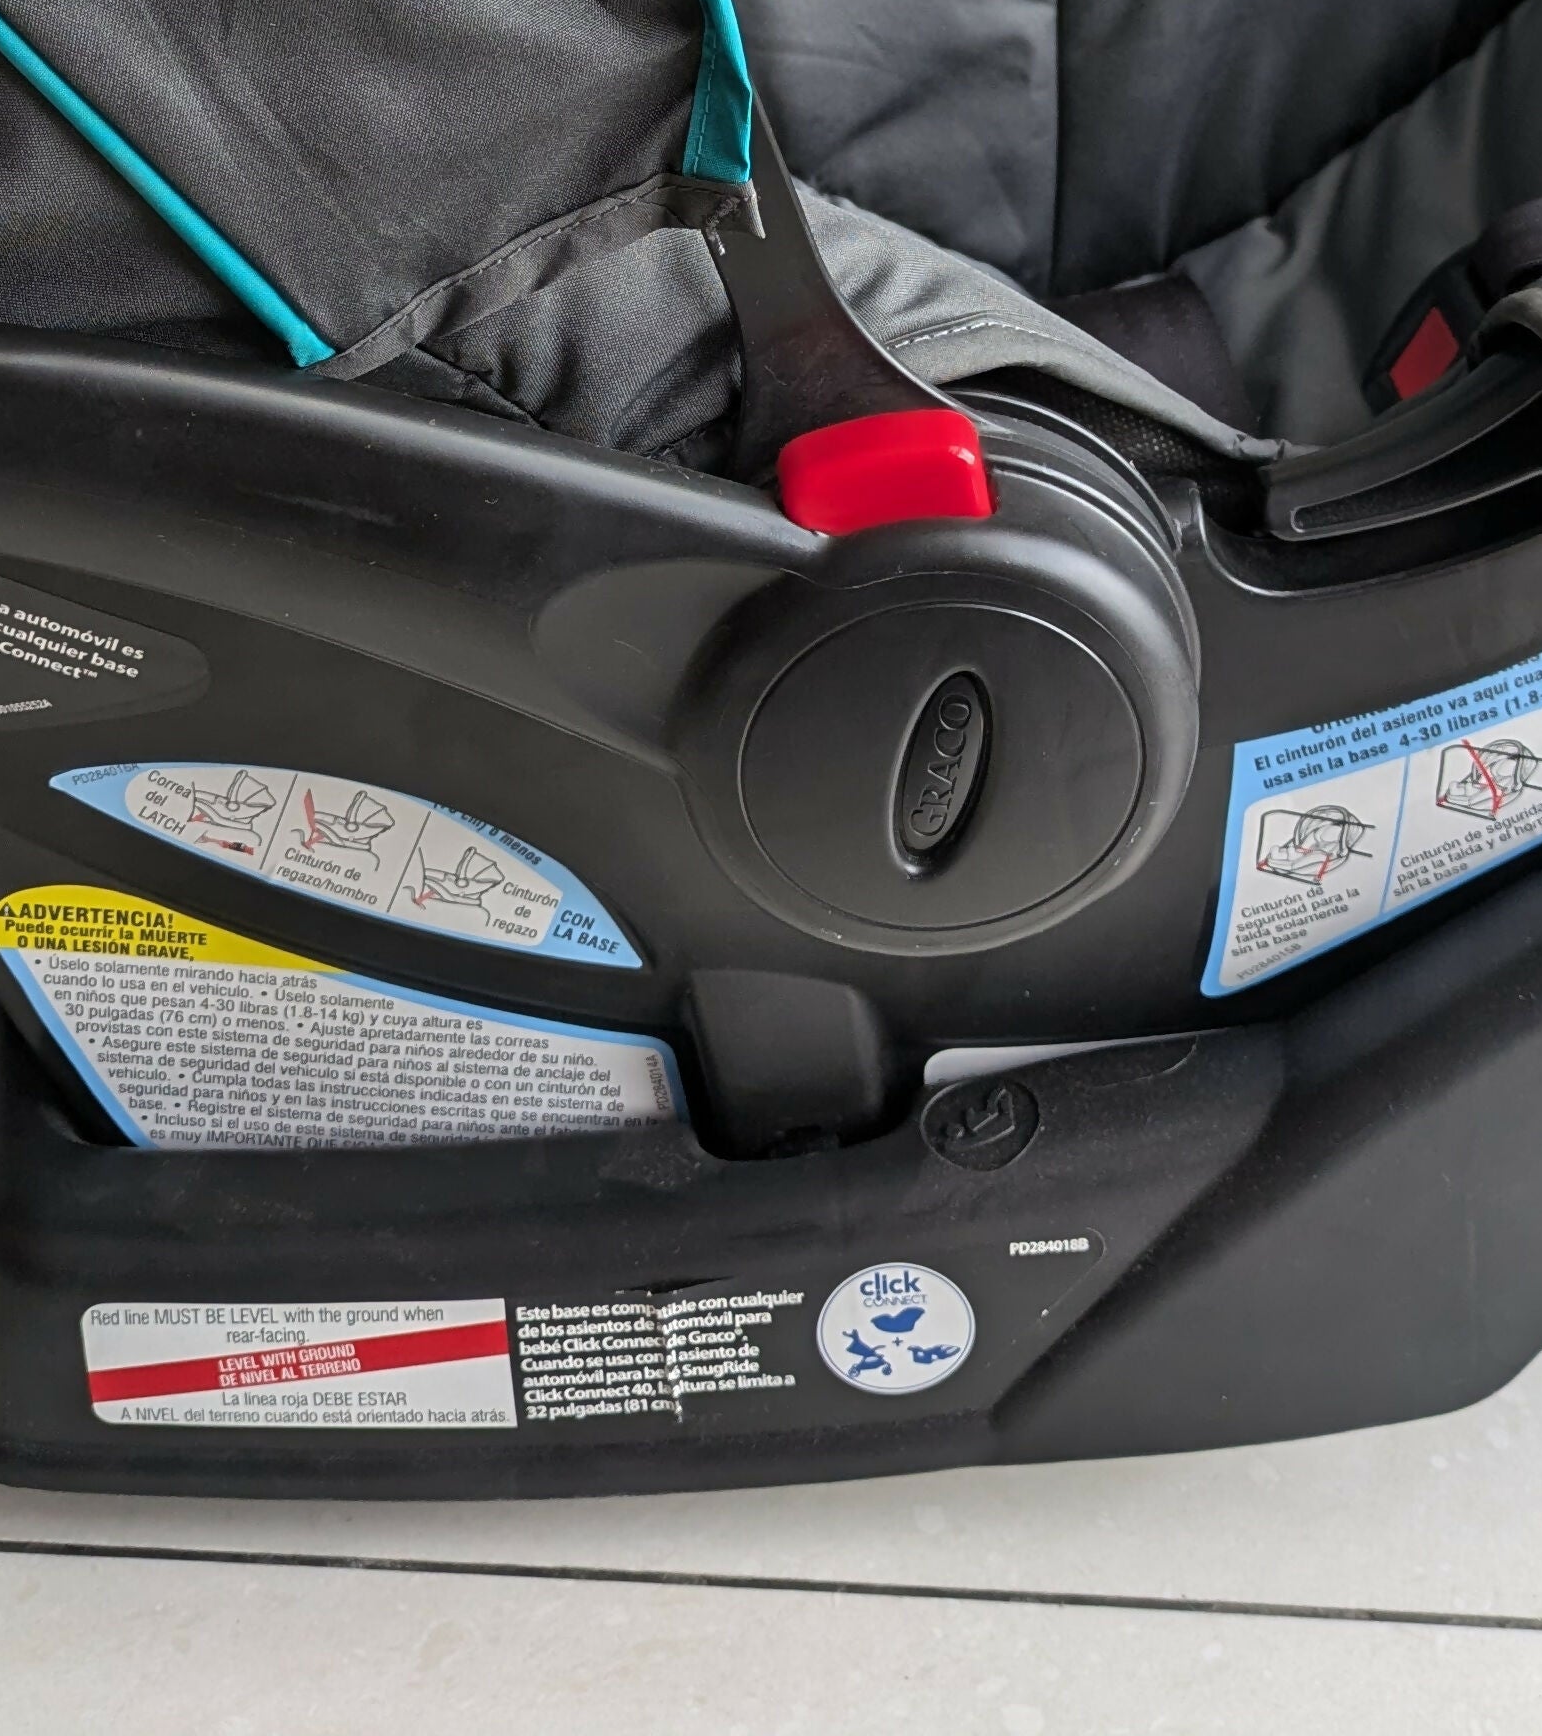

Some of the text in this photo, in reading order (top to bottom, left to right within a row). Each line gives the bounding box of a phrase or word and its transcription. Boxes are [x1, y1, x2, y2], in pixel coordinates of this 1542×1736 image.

[14, 610, 119, 652] automóvil
[121, 644, 145, 660] es
[91, 652, 139, 678] base
[1254, 756, 1271, 771] El
[1275, 736, 1346, 768] cinturón
[1351, 724, 1377, 742] del
[1382, 705, 1443, 734] asiento
[1448, 695, 1468, 710] va
[1473, 681, 1509, 704] aquí
[1263, 772, 1293, 789] usa
[1298, 764, 1324, 782] sin
[1328, 756, 1344, 770] la
[1348, 742, 1389, 764] base
[1399, 724, 1441, 747] 4-30
[1448, 707, 1498, 732] libras
[911, 694, 972, 836] GRACO
[147, 769, 191, 799] Correa
[145, 790, 168, 807] del
[139, 805, 186, 835] LATCH
[500, 833, 543, 865] menos
[1400, 838, 1460, 868] Cinturón
[1465, 828, 1482, 844] de
[284, 847, 361, 881] Cinturón de
[276, 863, 378, 905] regazo/hombro
[501, 881, 558, 908] Cinturón
[19, 903, 174, 929] ADVERTENCIA!
[514, 904, 531, 919] de
[560, 909, 595, 930] CON
[4, 919, 207, 946] Puede ocurrir la MUERTE
[493, 917, 538, 940] regazo
[552, 924, 620, 955] LA BASE
[17, 935, 195, 962] O UNA LESIÓN GRAVE,
[49, 953, 317, 989] Úselo solamente mirando hacia atrás
[44, 974, 97, 988] cuando
[102, 976, 115, 990] lo
[120, 980, 145, 992] usa
[151, 981, 167, 992] en
[173, 981, 185, 994] el
[275, 985, 315, 1004] Úselo
[321, 992, 395, 1010] solamente
[1009, 1238, 1089, 1256] PD284018B
[859, 1270, 921, 1300] click
[516, 1306, 552, 1322] Este
[553, 1303, 590, 1320] base
[592, 1306, 609, 1317] es
[698, 1297, 727, 1310] con
[729, 1290, 804, 1310] cualquier
[863, 1294, 927, 1308] CONNECT
[91, 1306, 443, 1326] Red line MUST BE LEVEL with the ground when
[518, 1325, 539, 1339] de
[540, 1322, 564, 1337] los
[566, 1319, 632, 1335] asientos
[633, 1317, 654, 1331] de
[735, 1311, 772, 1327] para
[226, 1327, 309, 1346] rear-facing.
[519, 1340, 561, 1356] bebé
[562, 1336, 601, 1352] Click
[666, 1333, 686, 1349] de
[219, 1343, 355, 1372] LEVEL WITH GROUND
[521, 1355, 584, 1372] Cuando
[585, 1355, 604, 1368] se
[606, 1354, 634, 1366] usa
[635, 1352, 664, 1364] con
[678, 1347, 735, 1362] asiento
[738, 1345, 759, 1359] de
[219, 1358, 361, 1387] DE NIVEL AL TERRENO
[522, 1359, 760, 1388] automóvil para SnugRide
[223, 1392, 407, 1408] La línea roja DEBE ESTAR
[524, 1373, 796, 1403] Click Connect 40, se limita a
[121, 1407, 509, 1423] A NIVEL del terreno cuando está orientado hacia atrás.
[525, 1398, 650, 1421] 32 pulgadas (81
